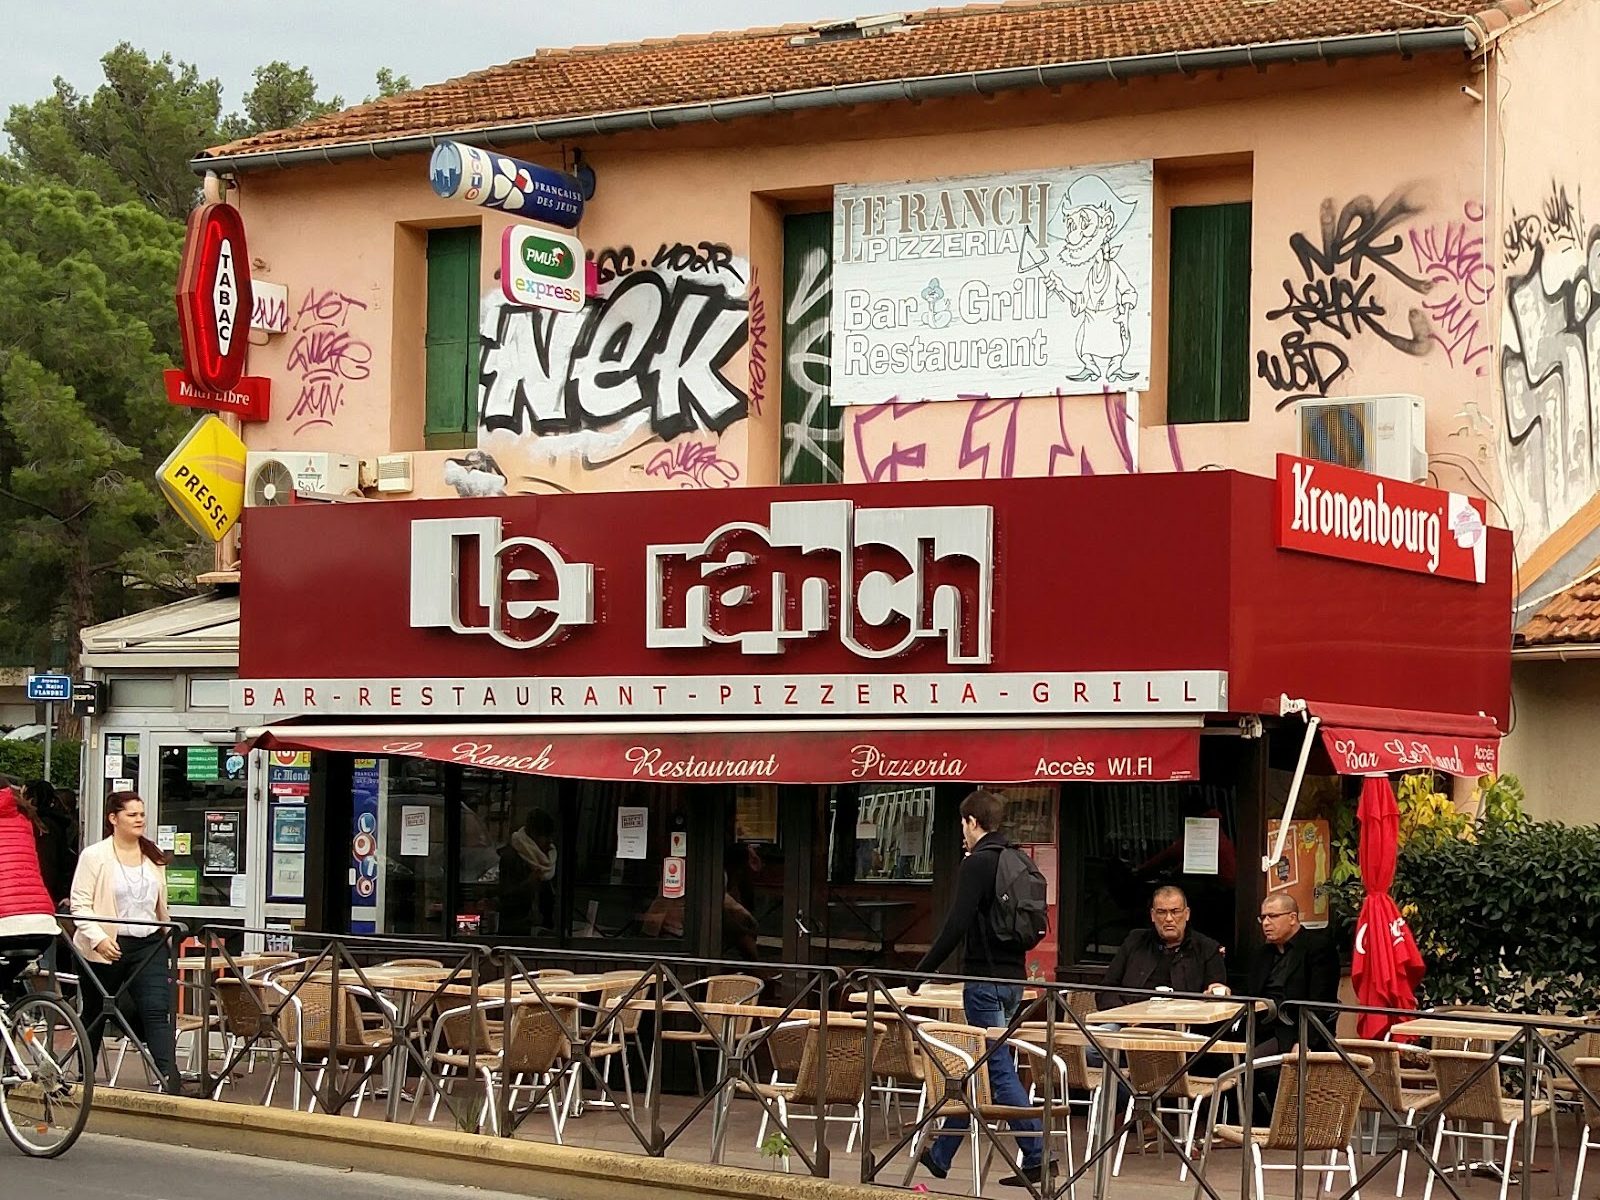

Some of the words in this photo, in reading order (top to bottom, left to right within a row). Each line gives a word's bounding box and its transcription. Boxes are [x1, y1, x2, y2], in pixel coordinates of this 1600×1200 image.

[536, 196, 554, 208] DES
[556, 200, 578, 214] JEUX
[898, 182, 1052, 250] RANCH
[526, 248, 551, 267] PMU
[866, 229, 1020, 263] PIZZERIA
[218, 253, 232, 342] TABAC
[515, 277, 581, 303] express
[844, 286, 919, 332] Bar
[958, 276, 1050, 325] Grill
[844, 328, 1049, 377] Restaurant
[174, 464, 228, 531] PRESSE
[1291, 461, 1440, 574] Kronenbourg
[451, 741, 555, 772] Ranch
[625, 745, 779, 778] Restaurant
[849, 744, 968, 779] Pizzeria
[1034, 755, 1095, 777] Accès
[1334, 739, 1380, 771] Bar
